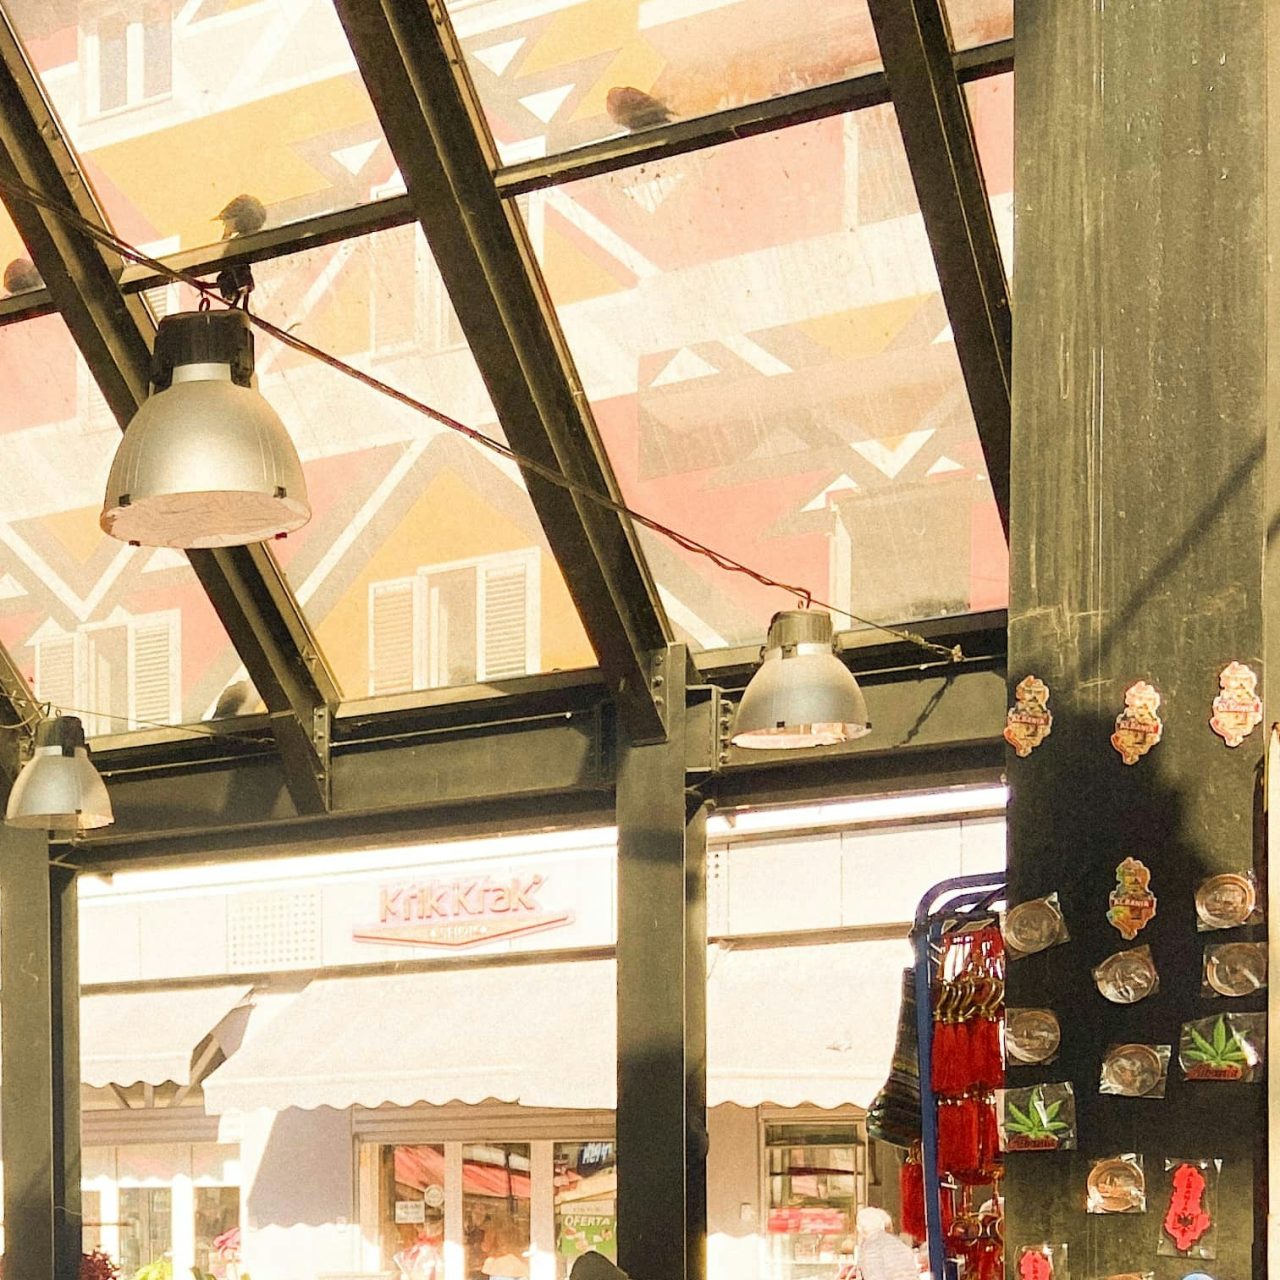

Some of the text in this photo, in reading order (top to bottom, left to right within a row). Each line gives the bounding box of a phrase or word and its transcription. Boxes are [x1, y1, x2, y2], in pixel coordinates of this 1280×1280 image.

[1112, 898, 1151, 908] ALBANIA
[1182, 1171, 1195, 1213] ALBANIA
[564, 1215, 611, 1227] OFERTA
